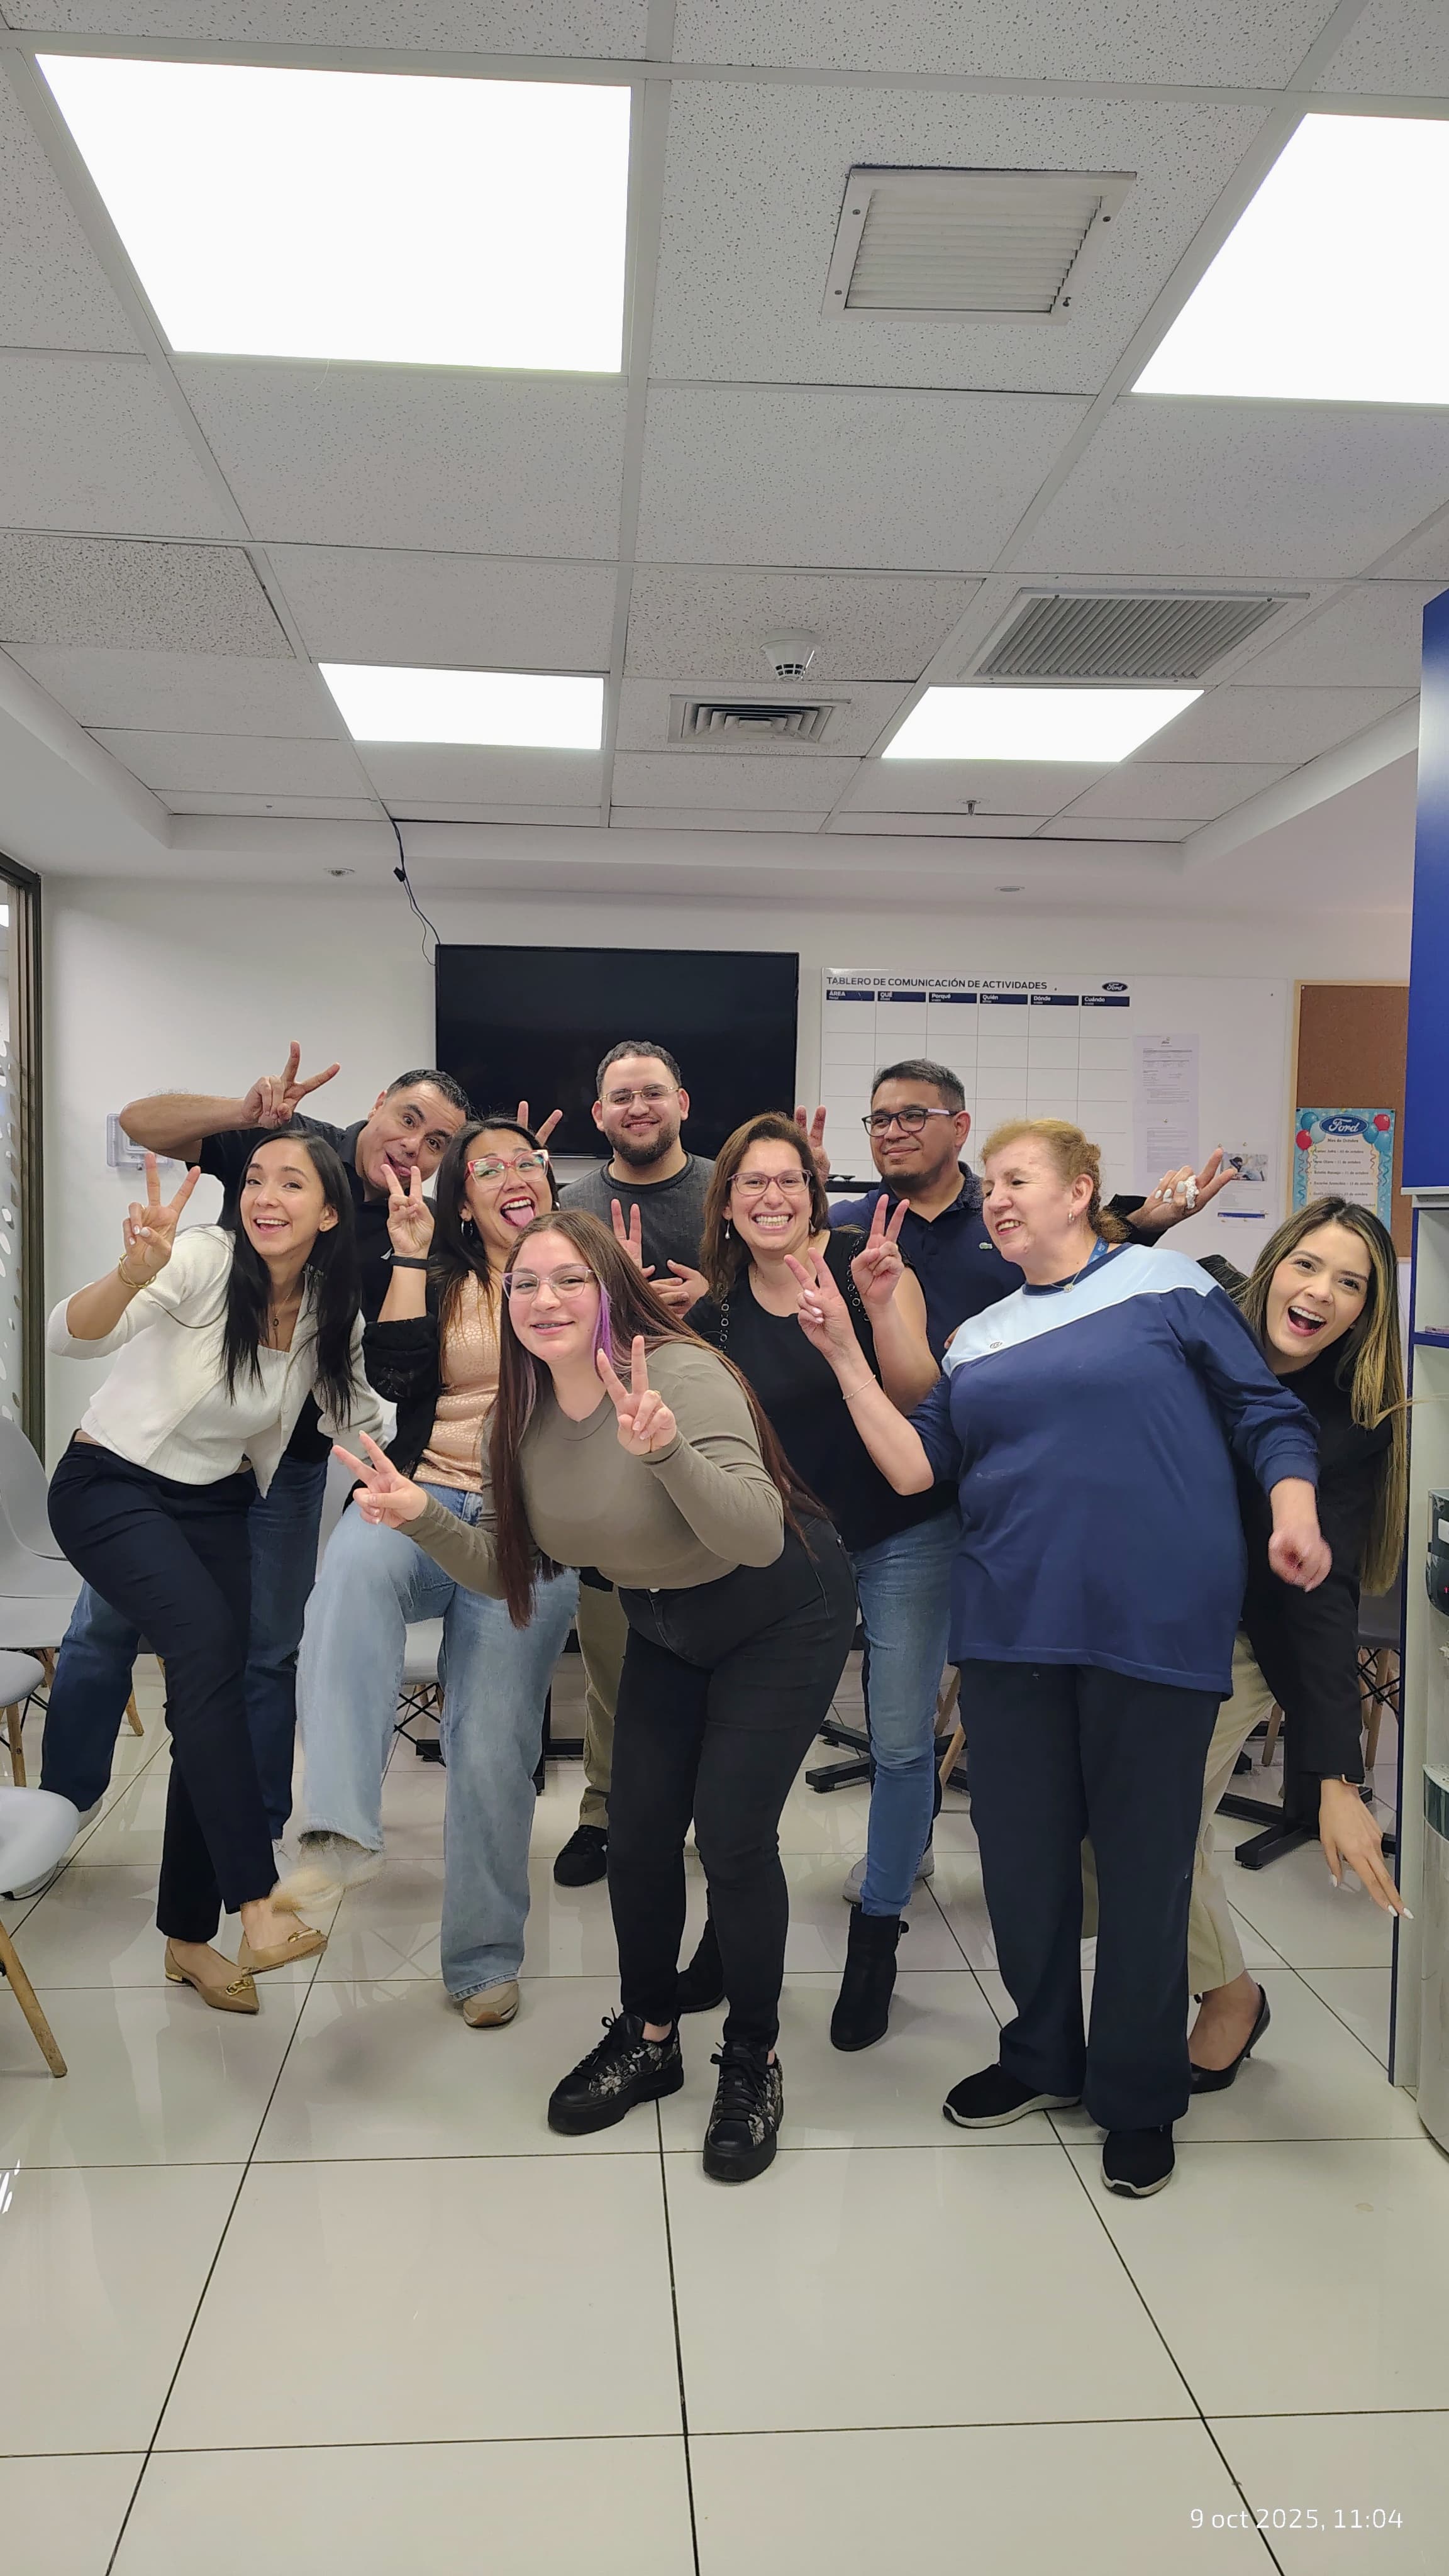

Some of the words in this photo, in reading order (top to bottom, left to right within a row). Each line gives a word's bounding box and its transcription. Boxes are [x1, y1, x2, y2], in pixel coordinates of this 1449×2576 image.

[826, 977, 871, 985] TABLERO
[888, 978, 966, 987] COMUNICACIÓN
[982, 980, 1048, 989] ACTIVIDADES
[1328, 1118, 1360, 1132] Ford
